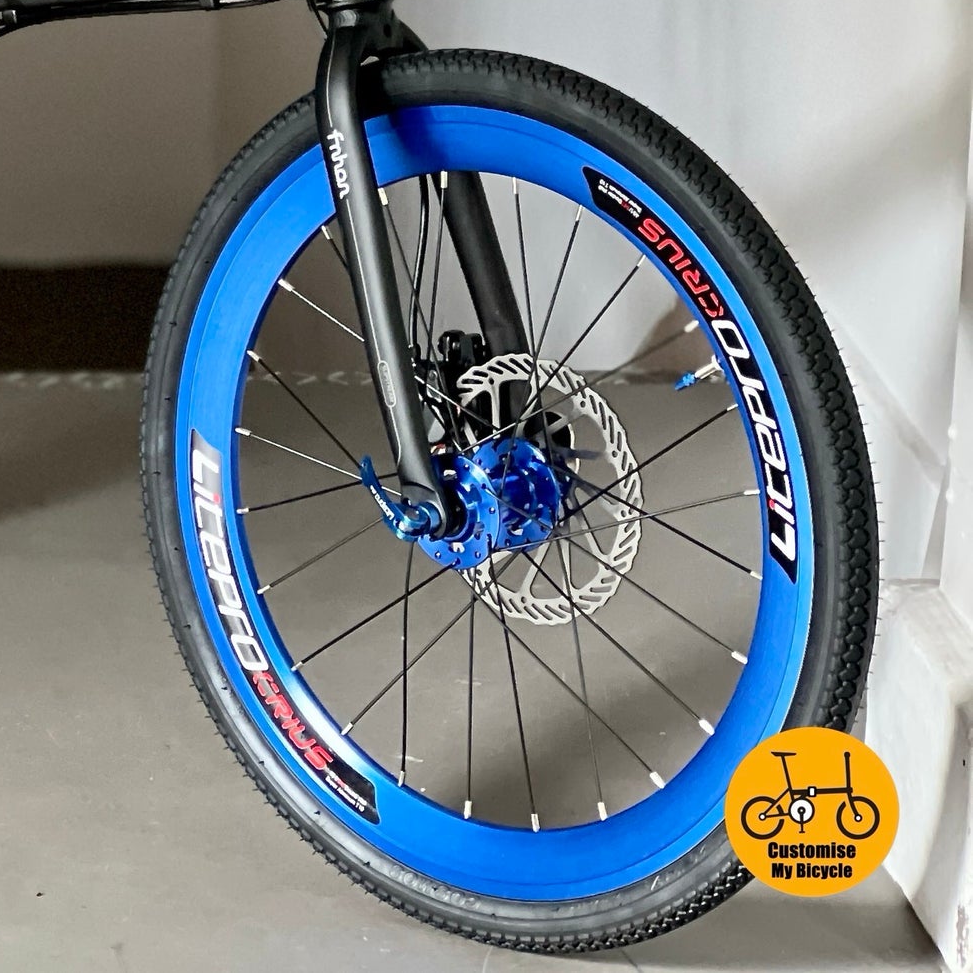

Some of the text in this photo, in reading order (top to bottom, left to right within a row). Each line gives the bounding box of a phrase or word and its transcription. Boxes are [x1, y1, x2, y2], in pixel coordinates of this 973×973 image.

[327, 129, 350, 200] fnhon
[637, 217, 724, 318] CRIUS
[252, 671, 334, 771] CRIUS
